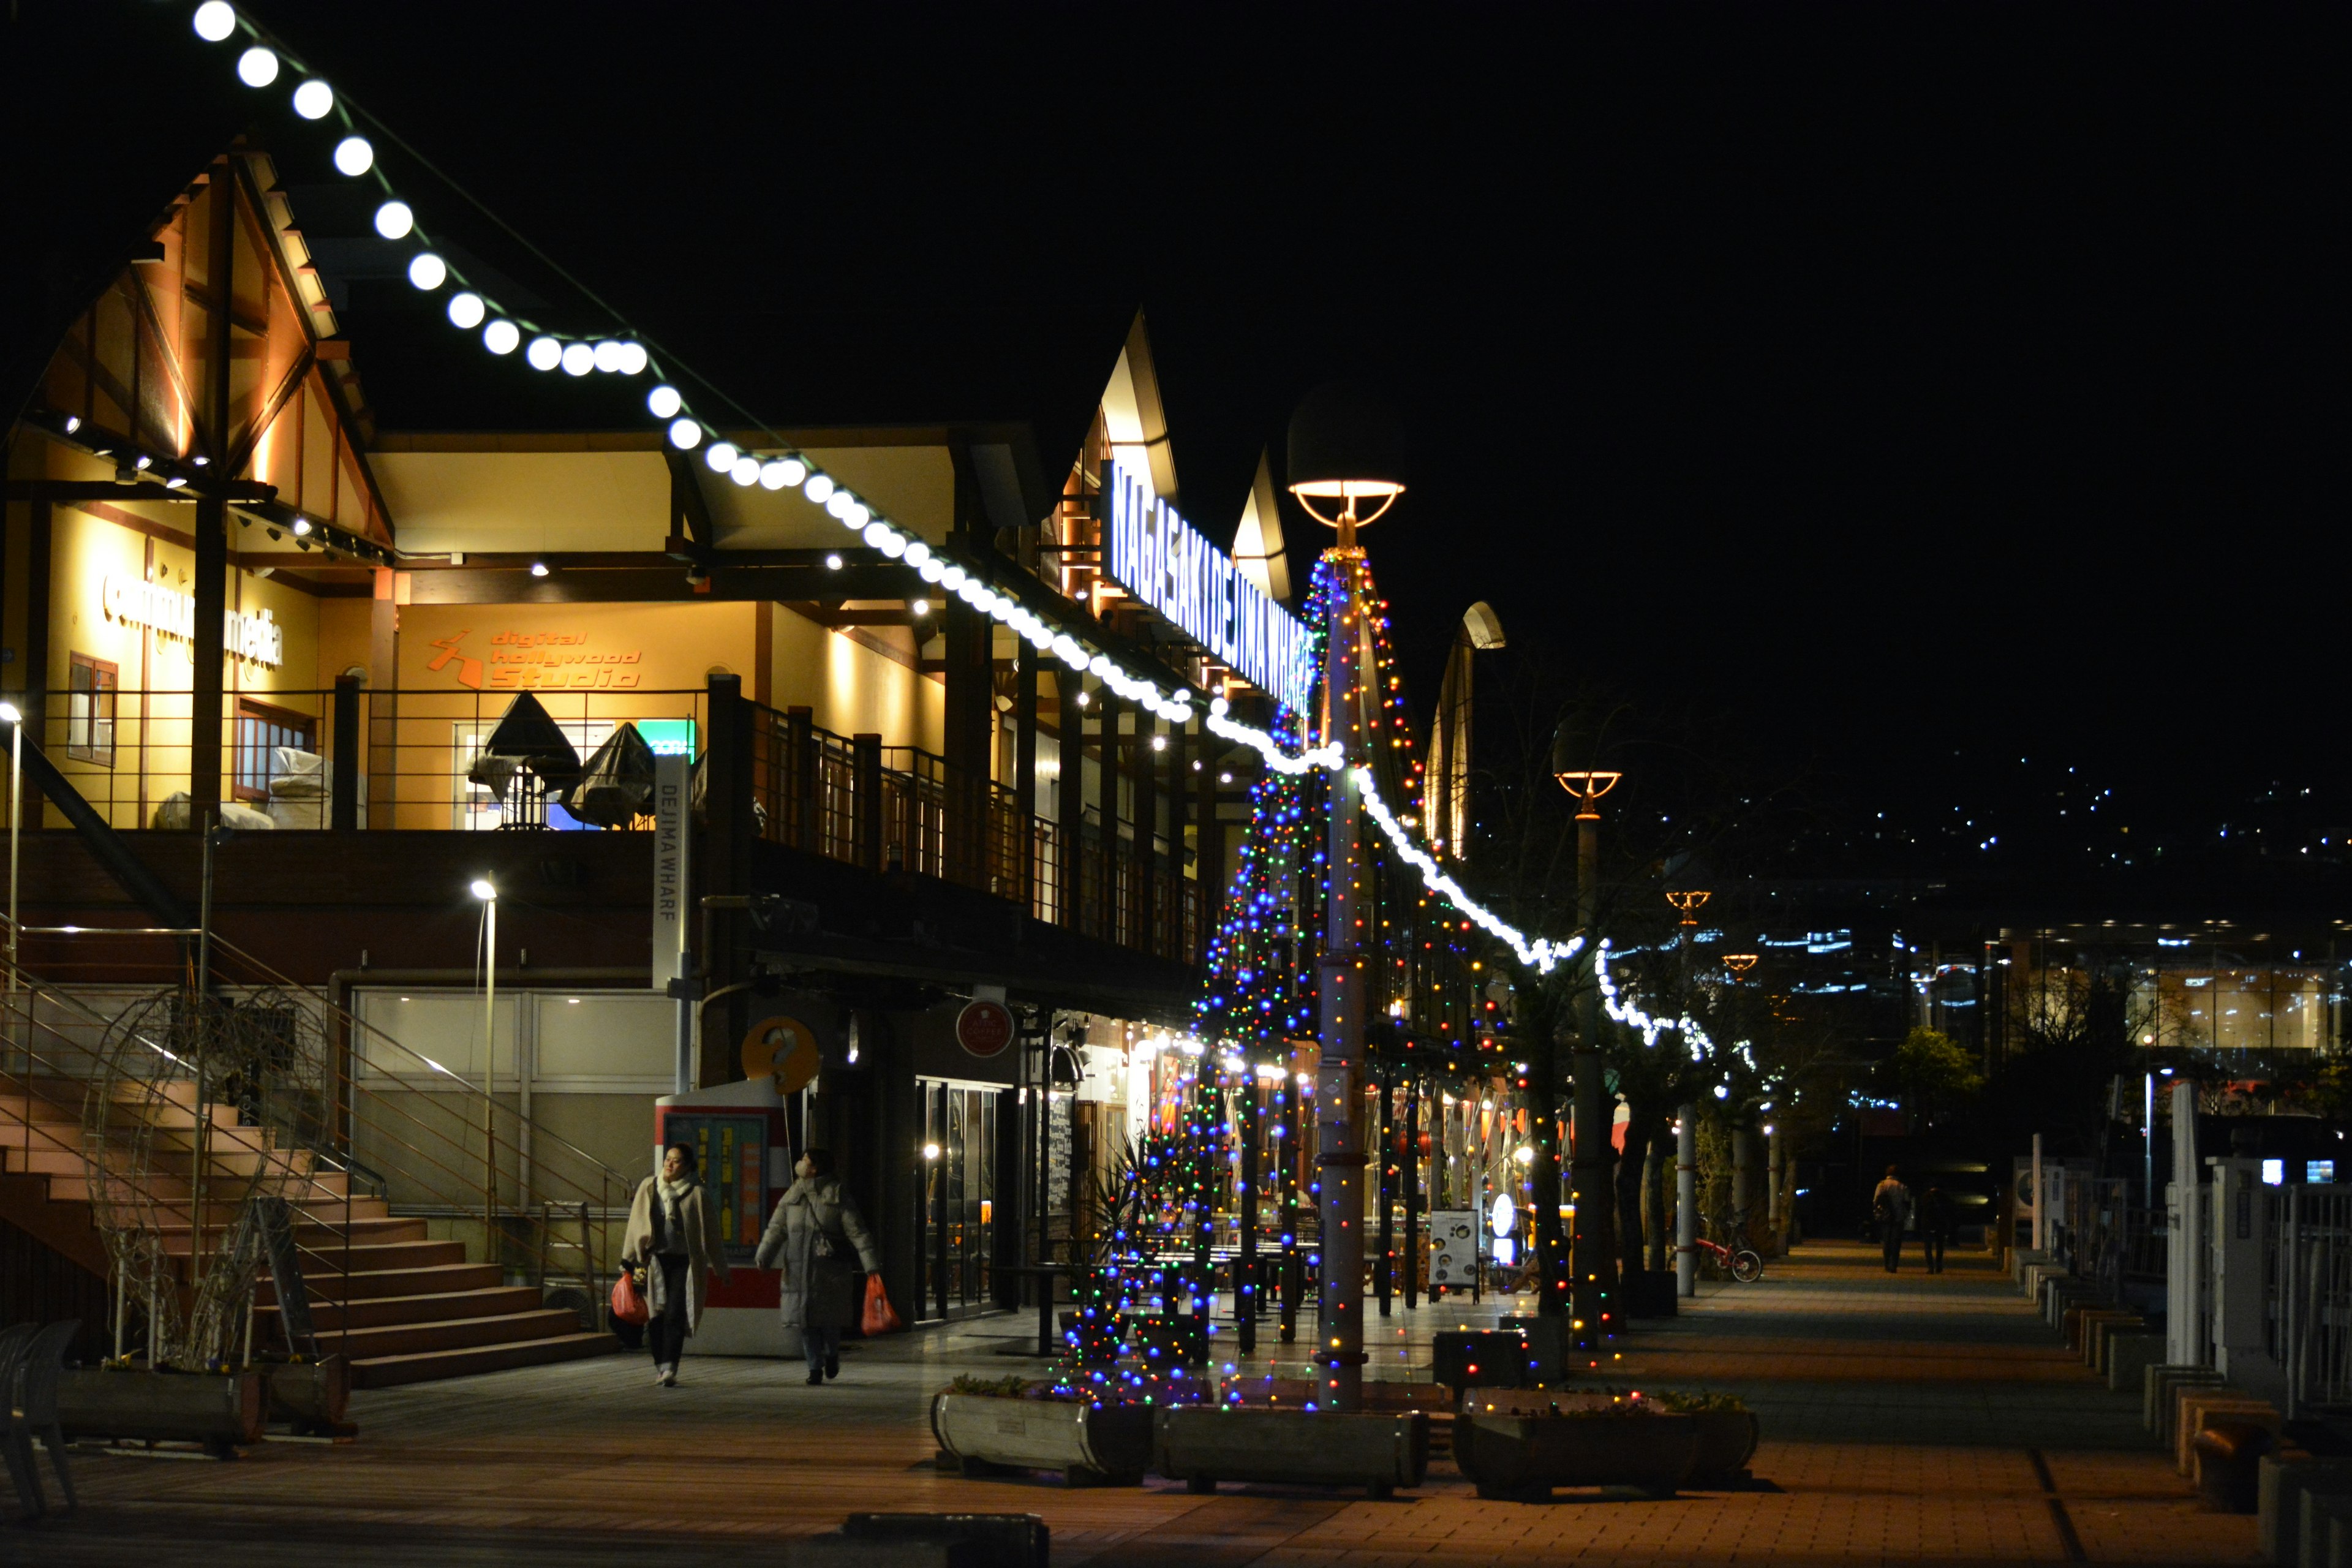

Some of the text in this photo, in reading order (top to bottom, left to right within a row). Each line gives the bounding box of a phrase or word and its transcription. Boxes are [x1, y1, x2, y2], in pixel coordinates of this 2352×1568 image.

[1112, 462, 1209, 647] NAGASAKI
[1210, 546, 1266, 690] DEJIMA
[223, 608, 282, 666] media
[491, 630, 588, 648] digital
[490, 649, 641, 667] hollywood
[489, 668, 641, 688] Studio
[660, 785, 677, 921] DEJIMA WHARF
